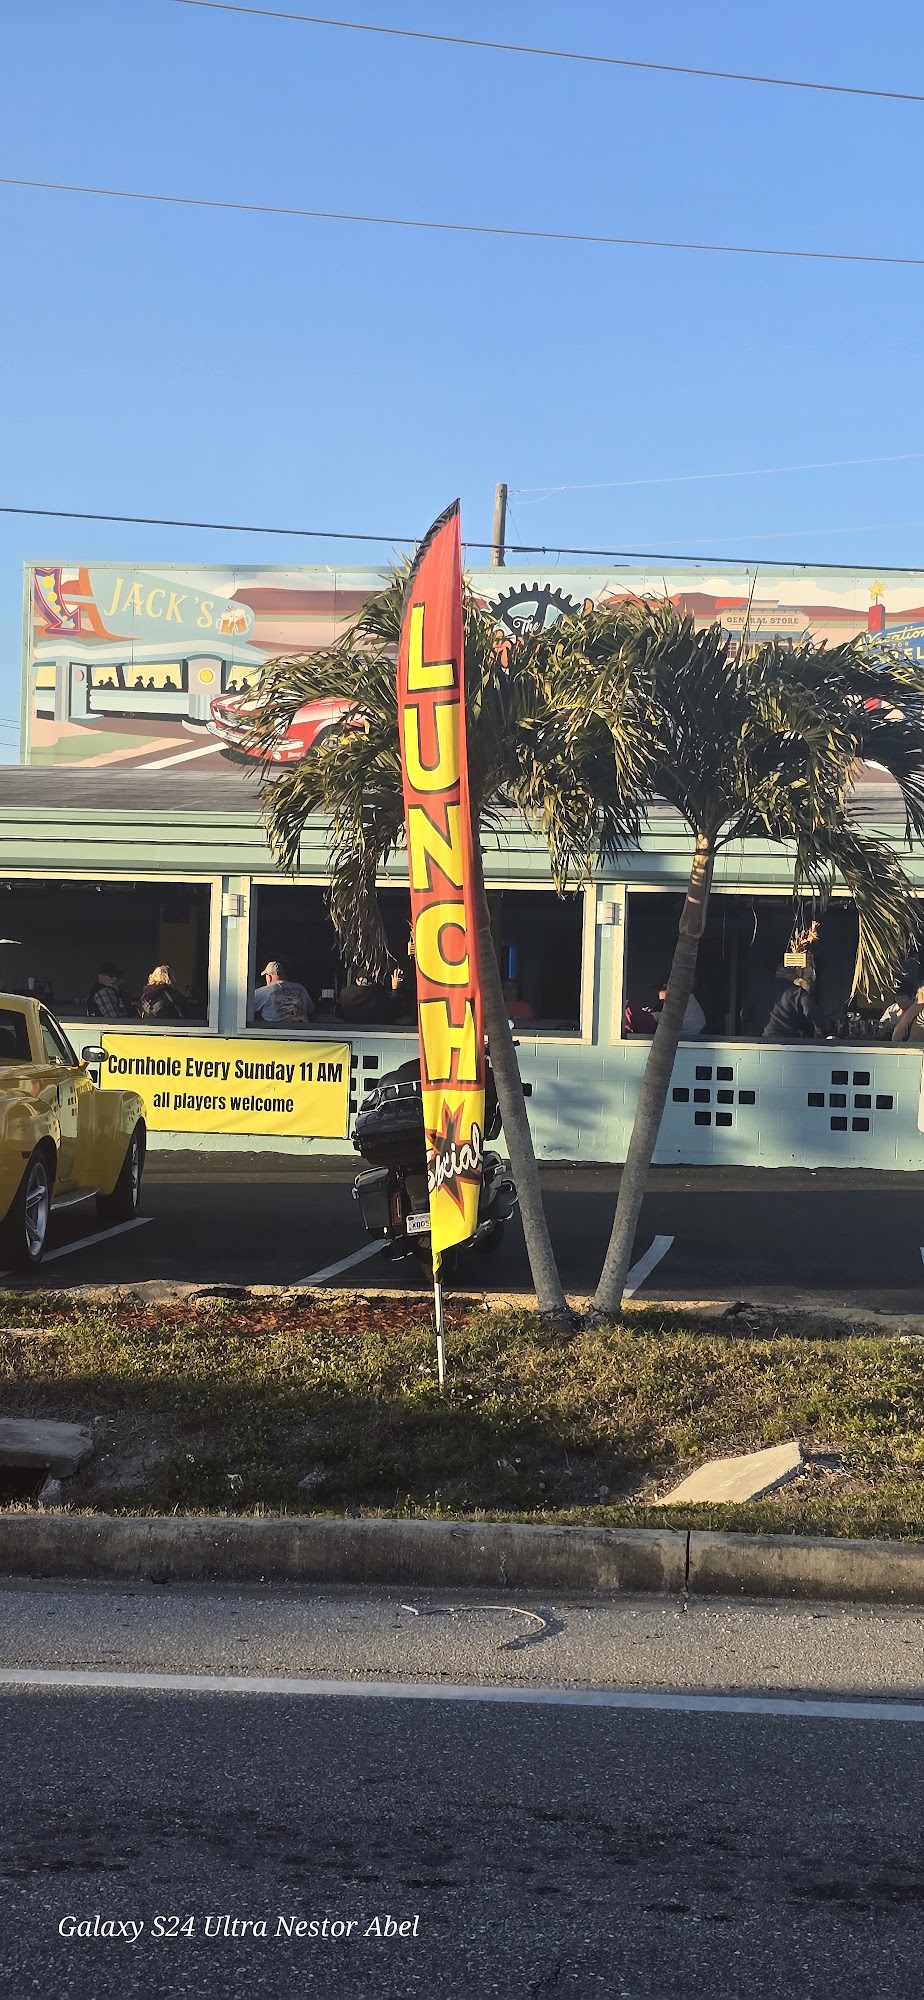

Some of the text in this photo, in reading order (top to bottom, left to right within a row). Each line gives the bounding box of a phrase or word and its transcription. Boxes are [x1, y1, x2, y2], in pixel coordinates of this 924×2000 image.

[104, 577, 215, 628] JACK'S
[512, 616, 540, 636] The
[726, 616, 768, 624] GENRAL
[403, 602, 478, 1083] LUNCH
[108, 1054, 344, 1084] Cornhole Every Sunday 11 AM
[153, 1091, 295, 1113] all players welcome
[426, 1122, 482, 1193] Spcial
